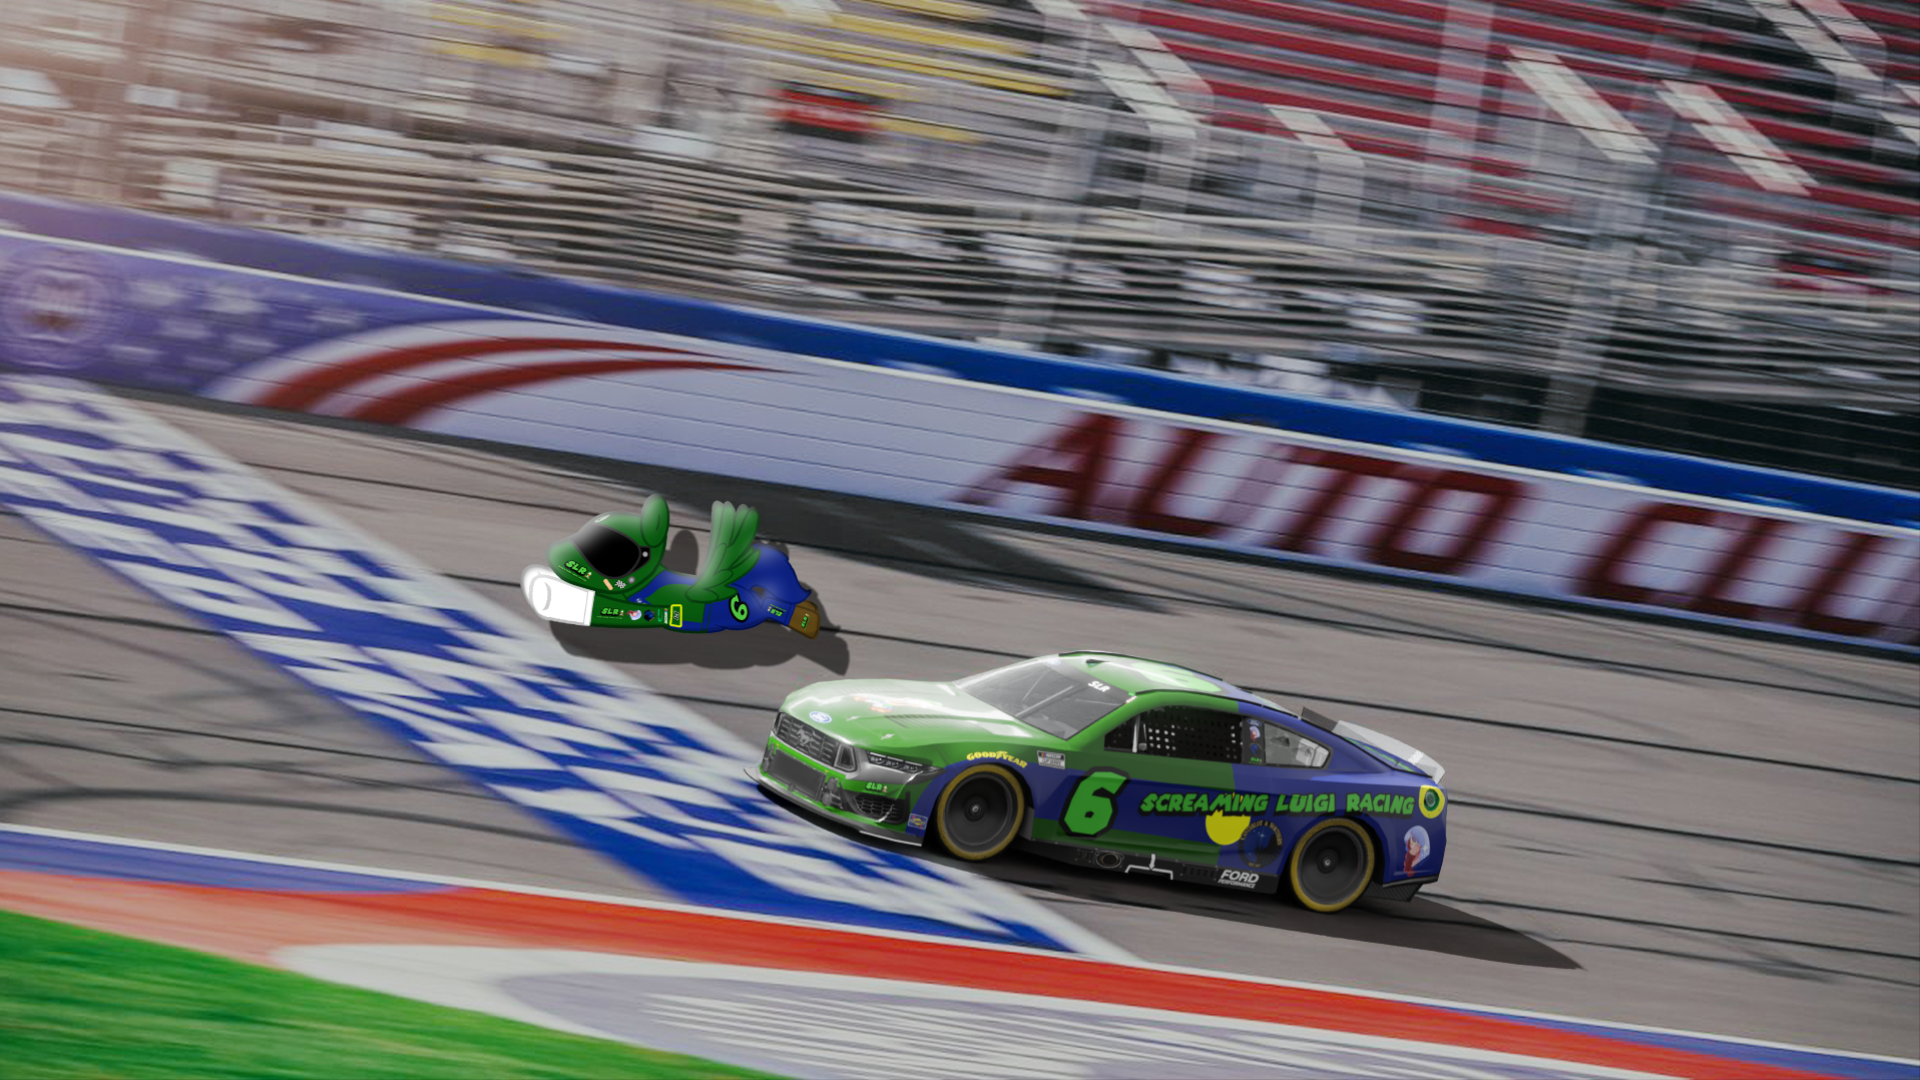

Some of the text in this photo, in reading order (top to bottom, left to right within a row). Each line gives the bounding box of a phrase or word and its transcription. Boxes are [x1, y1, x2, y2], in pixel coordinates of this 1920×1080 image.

[962, 410, 1535, 575] AUTO
[565, 560, 587, 576] SLR
[601, 607, 619, 616] SLR
[1087, 680, 1110, 692] SLR
[966, 750, 1027, 769] GOODYEAR
[865, 781, 882, 791] SLR
[1061, 768, 1129, 838] 6
[1139, 792, 1269, 814] SCREAMING
[1275, 792, 1336, 814] LUIGI
[1345, 792, 1415, 816] RACING
[1217, 878, 1256, 889] PERFORMANCE
[1220, 869, 1259, 883] FORD
